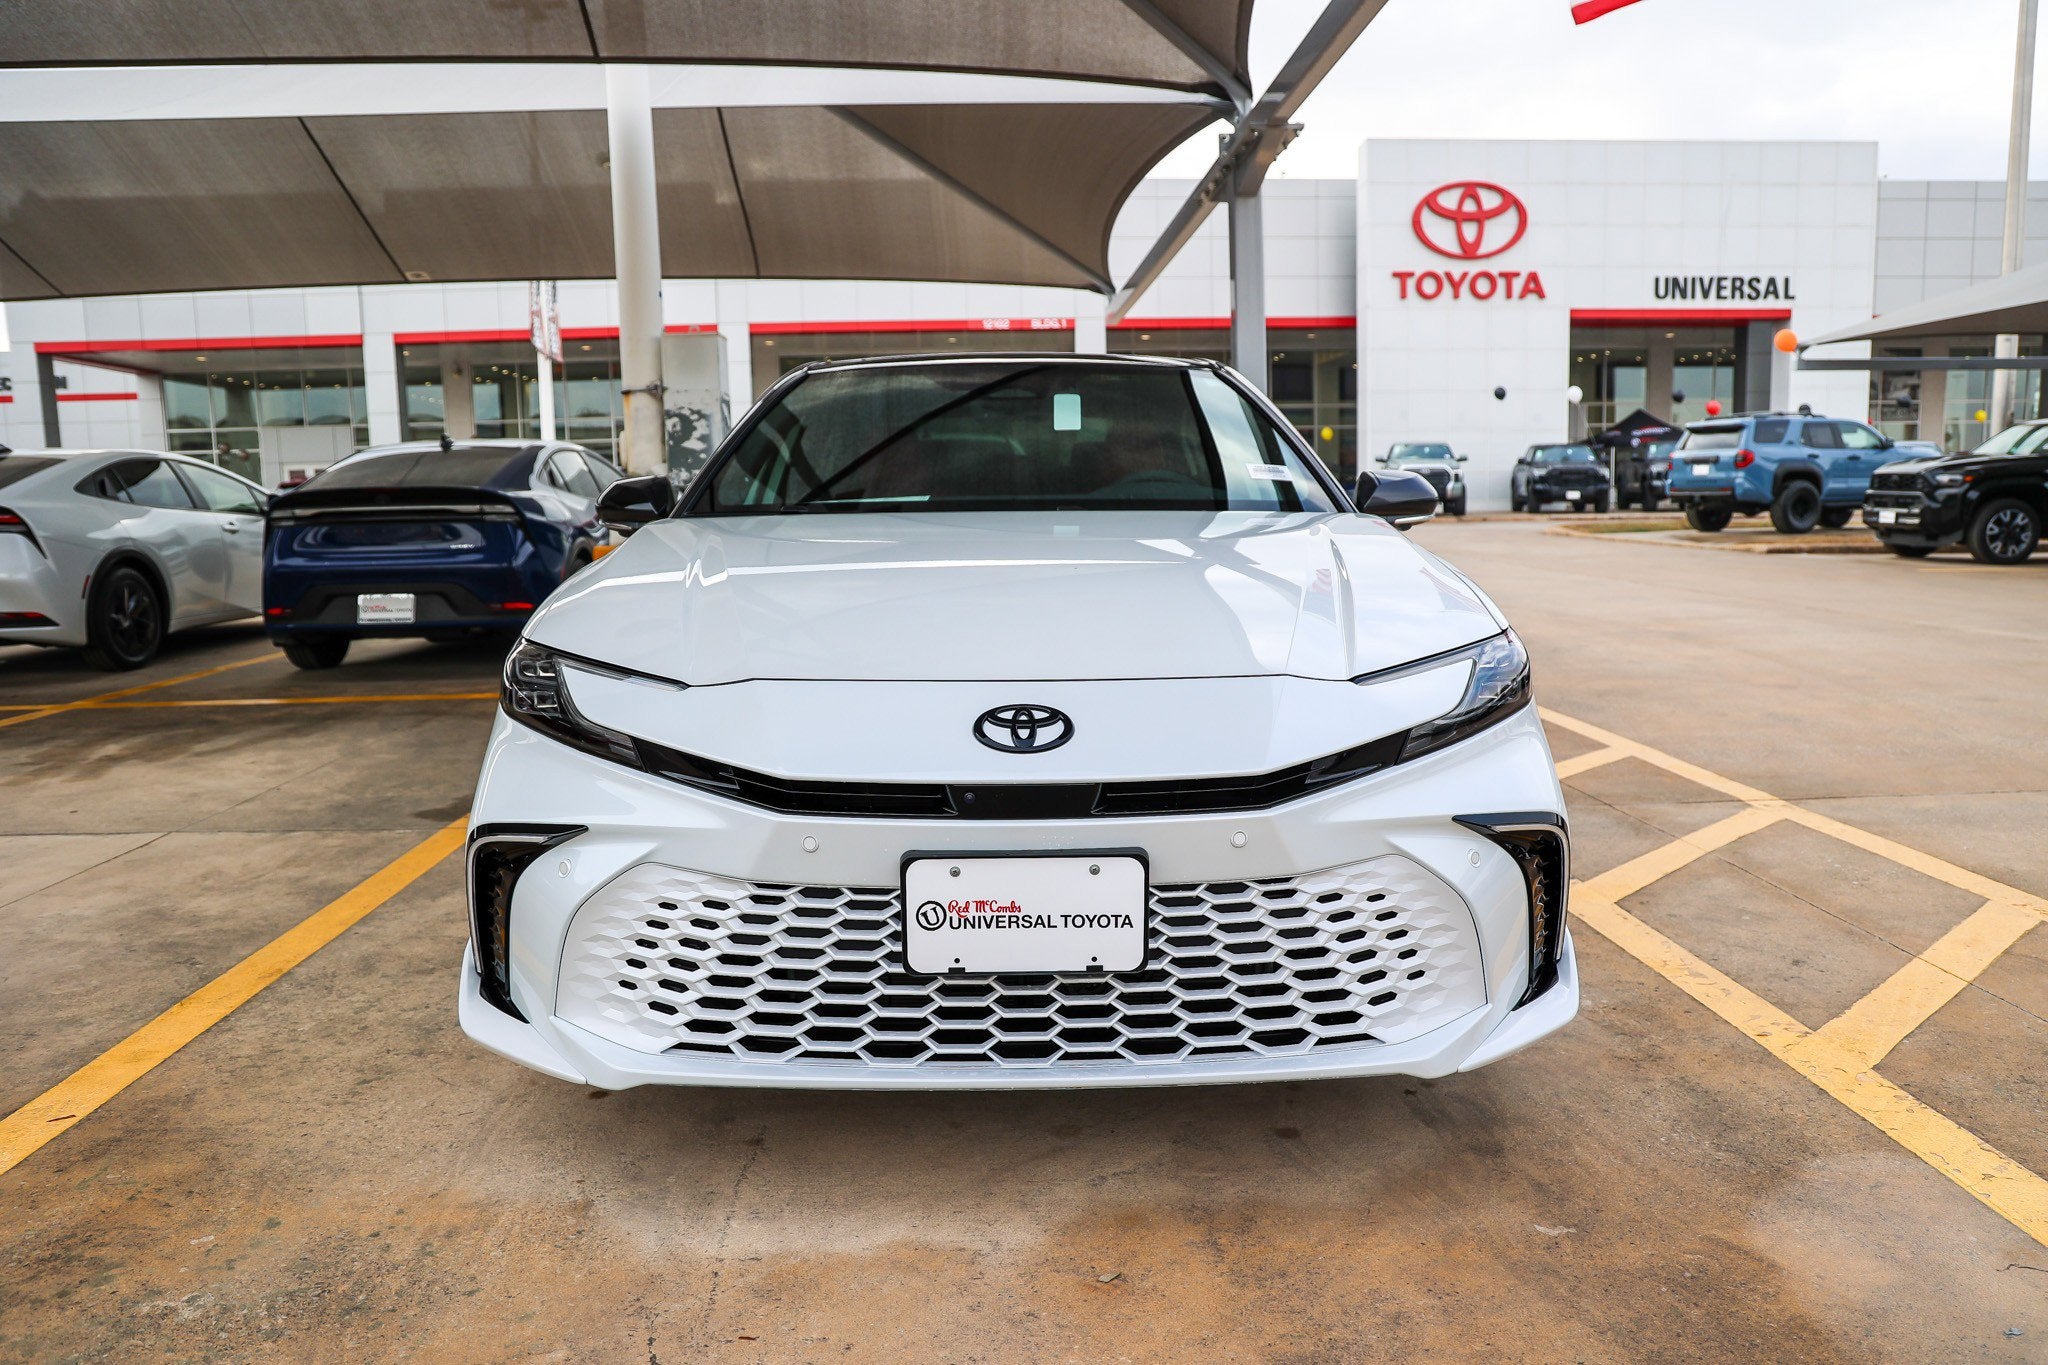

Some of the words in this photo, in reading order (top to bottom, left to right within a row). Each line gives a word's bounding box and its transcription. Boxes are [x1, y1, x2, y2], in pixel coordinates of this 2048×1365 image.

[1392, 271, 1546, 299] TOYOTA
[1655, 276, 1795, 300] UNIVERSAL
[948, 900, 970, 918] Red
[972, 900, 1021, 913] McCombs
[949, 914, 1058, 930] UNIVERSAL
[1060, 914, 1134, 928] TOYOTA
